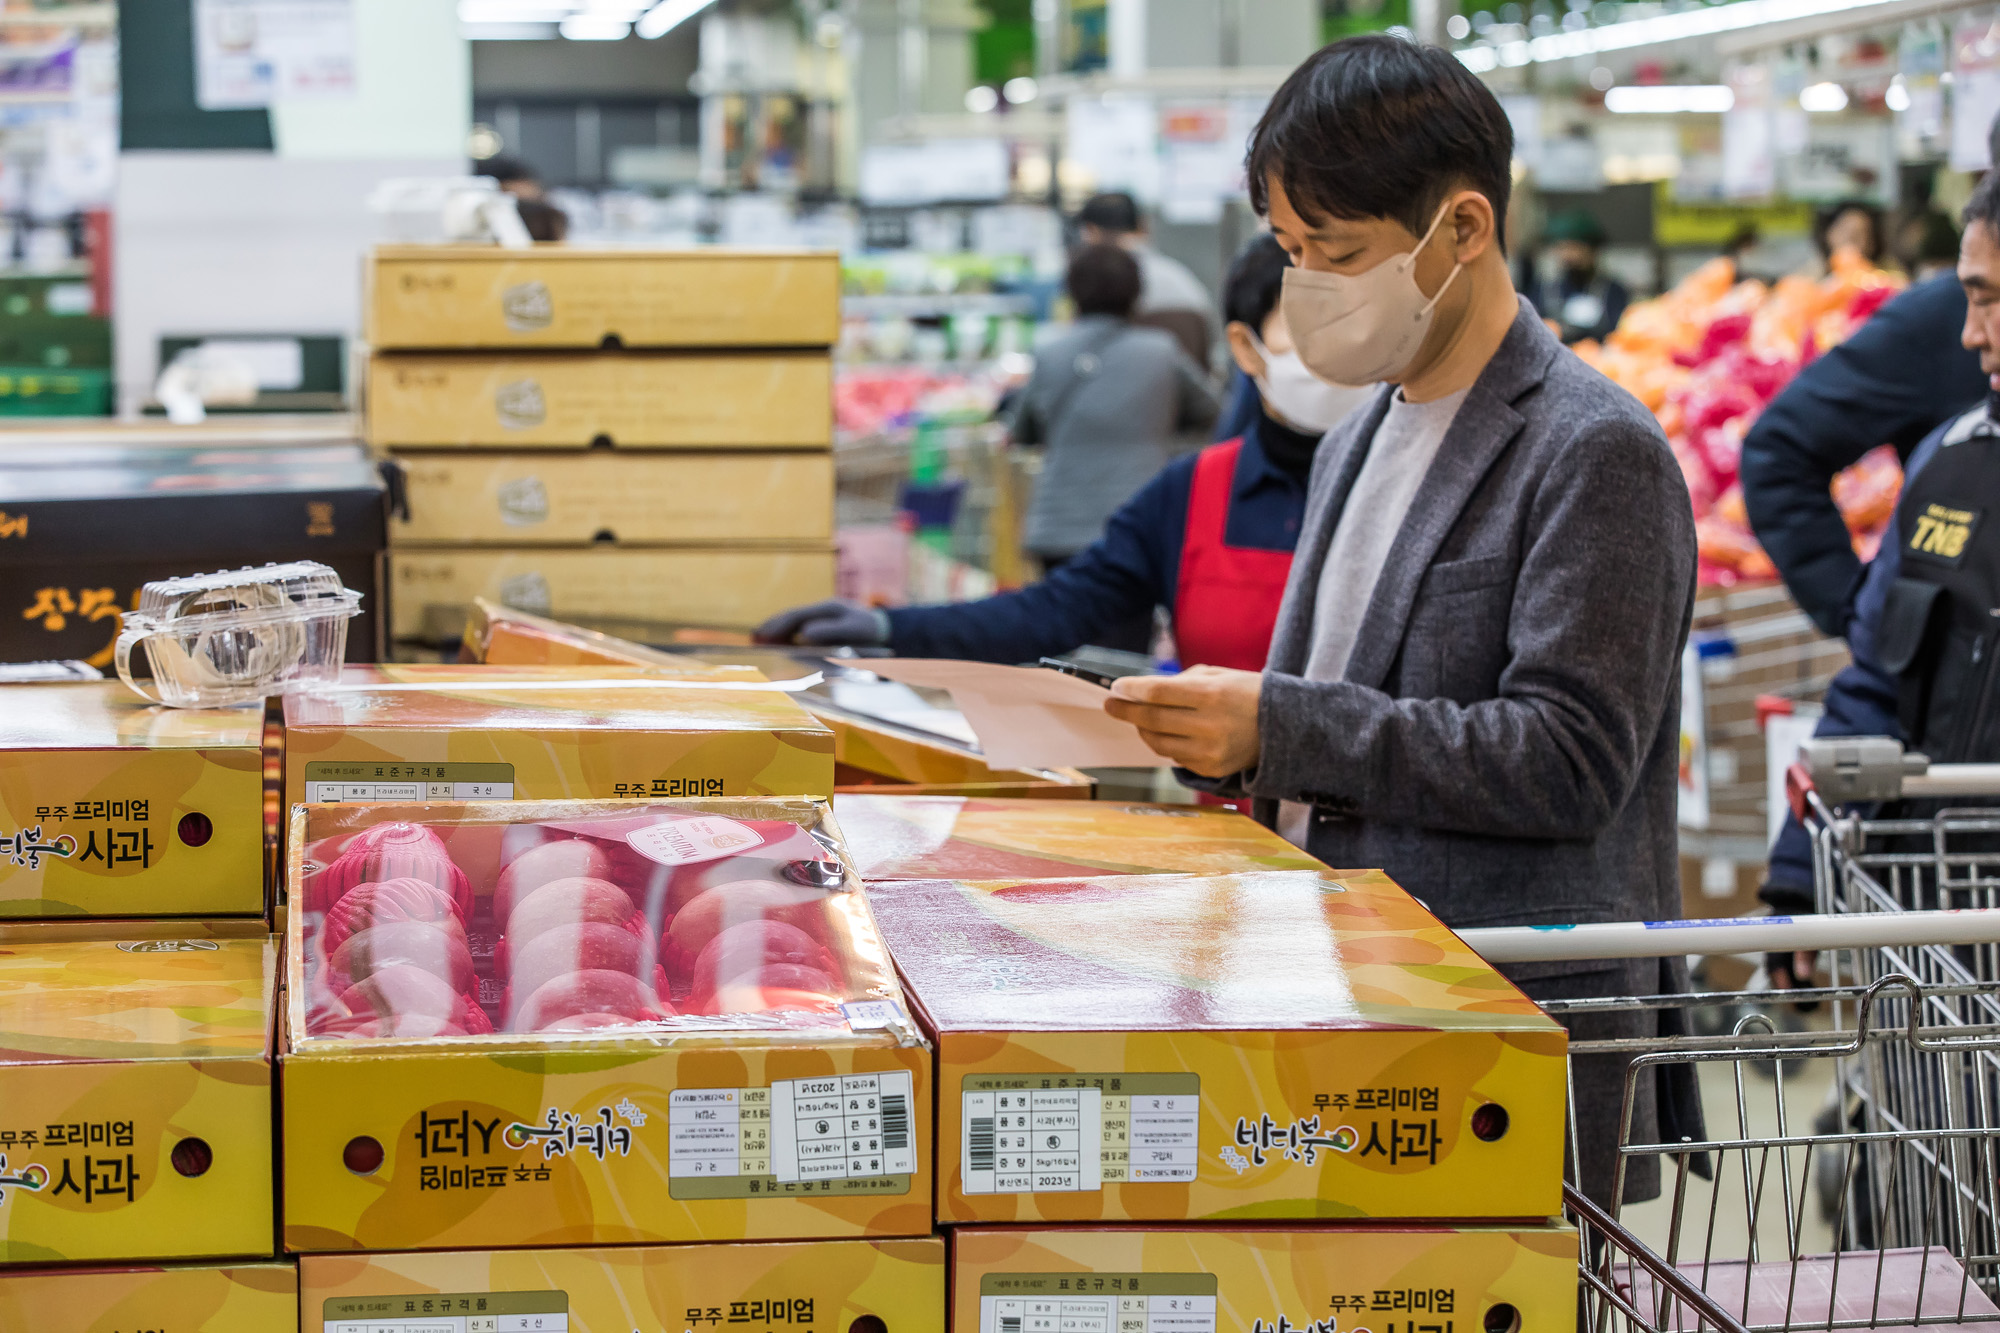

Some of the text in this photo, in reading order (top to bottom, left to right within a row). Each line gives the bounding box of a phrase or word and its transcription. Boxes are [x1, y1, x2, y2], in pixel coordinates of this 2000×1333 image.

[1910, 515, 1971, 558] TNB
[613, 778, 724, 798] 무주 프리미엄
[35, 799, 149, 822] 무주 프리미엄
[79, 828, 153, 869] 사과
[656, 825, 701, 860] PREMIUM
[801, 1082, 835, 1093] 2023년
[1313, 1087, 1439, 1112] 무주 프리미엄
[0, 1121, 133, 1149] 무주 프리미엄
[415, 1110, 501, 1158] 사과
[1236, 1114, 1350, 1165] 반딧불
[1360, 1119, 1442, 1165] 사과
[52, 1154, 140, 1203] 사과
[421, 1163, 552, 1191] 무주 프리미엄
[1039, 1177, 1072, 1186] 2023년
[685, 1298, 814, 1326] 무주 프리미엄
[1329, 1289, 1455, 1313] 무주 프리미엄
